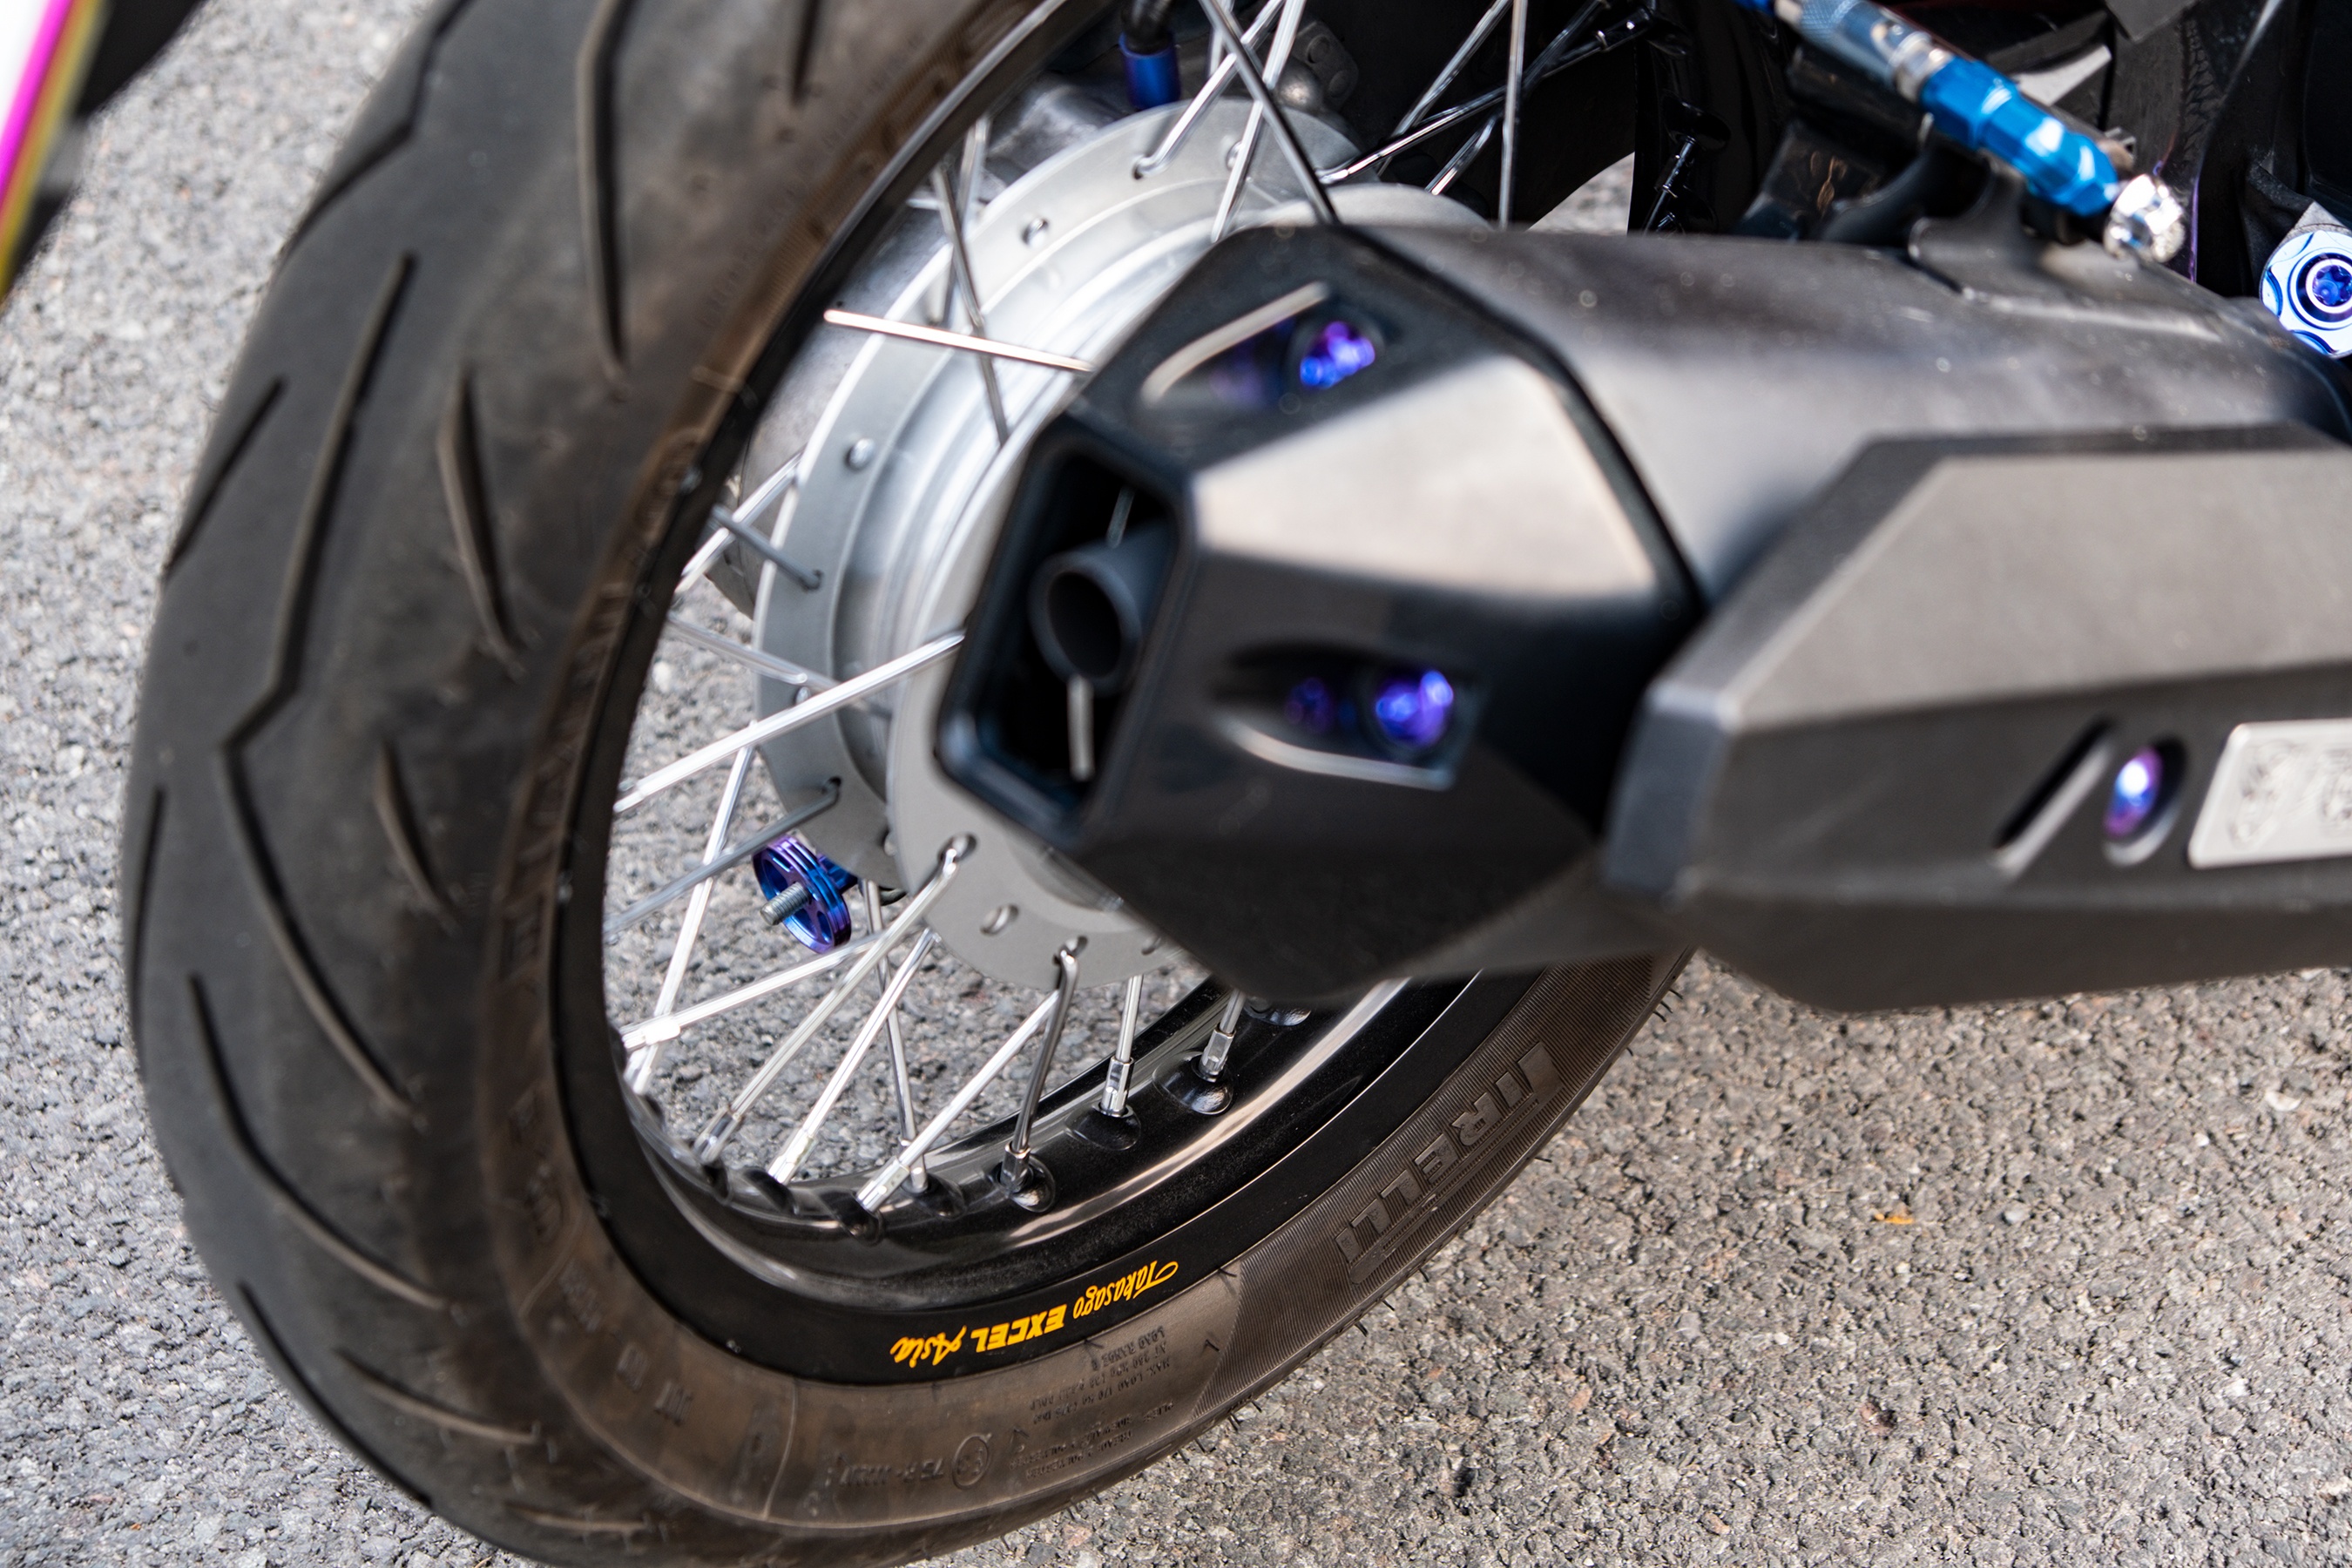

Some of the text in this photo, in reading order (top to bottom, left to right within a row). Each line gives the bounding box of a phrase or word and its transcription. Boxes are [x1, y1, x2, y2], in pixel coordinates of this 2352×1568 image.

[1335, 1041, 1564, 1285] PIRELLI
[889, 1260, 1179, 1369] Takasago EXCEL Asia
